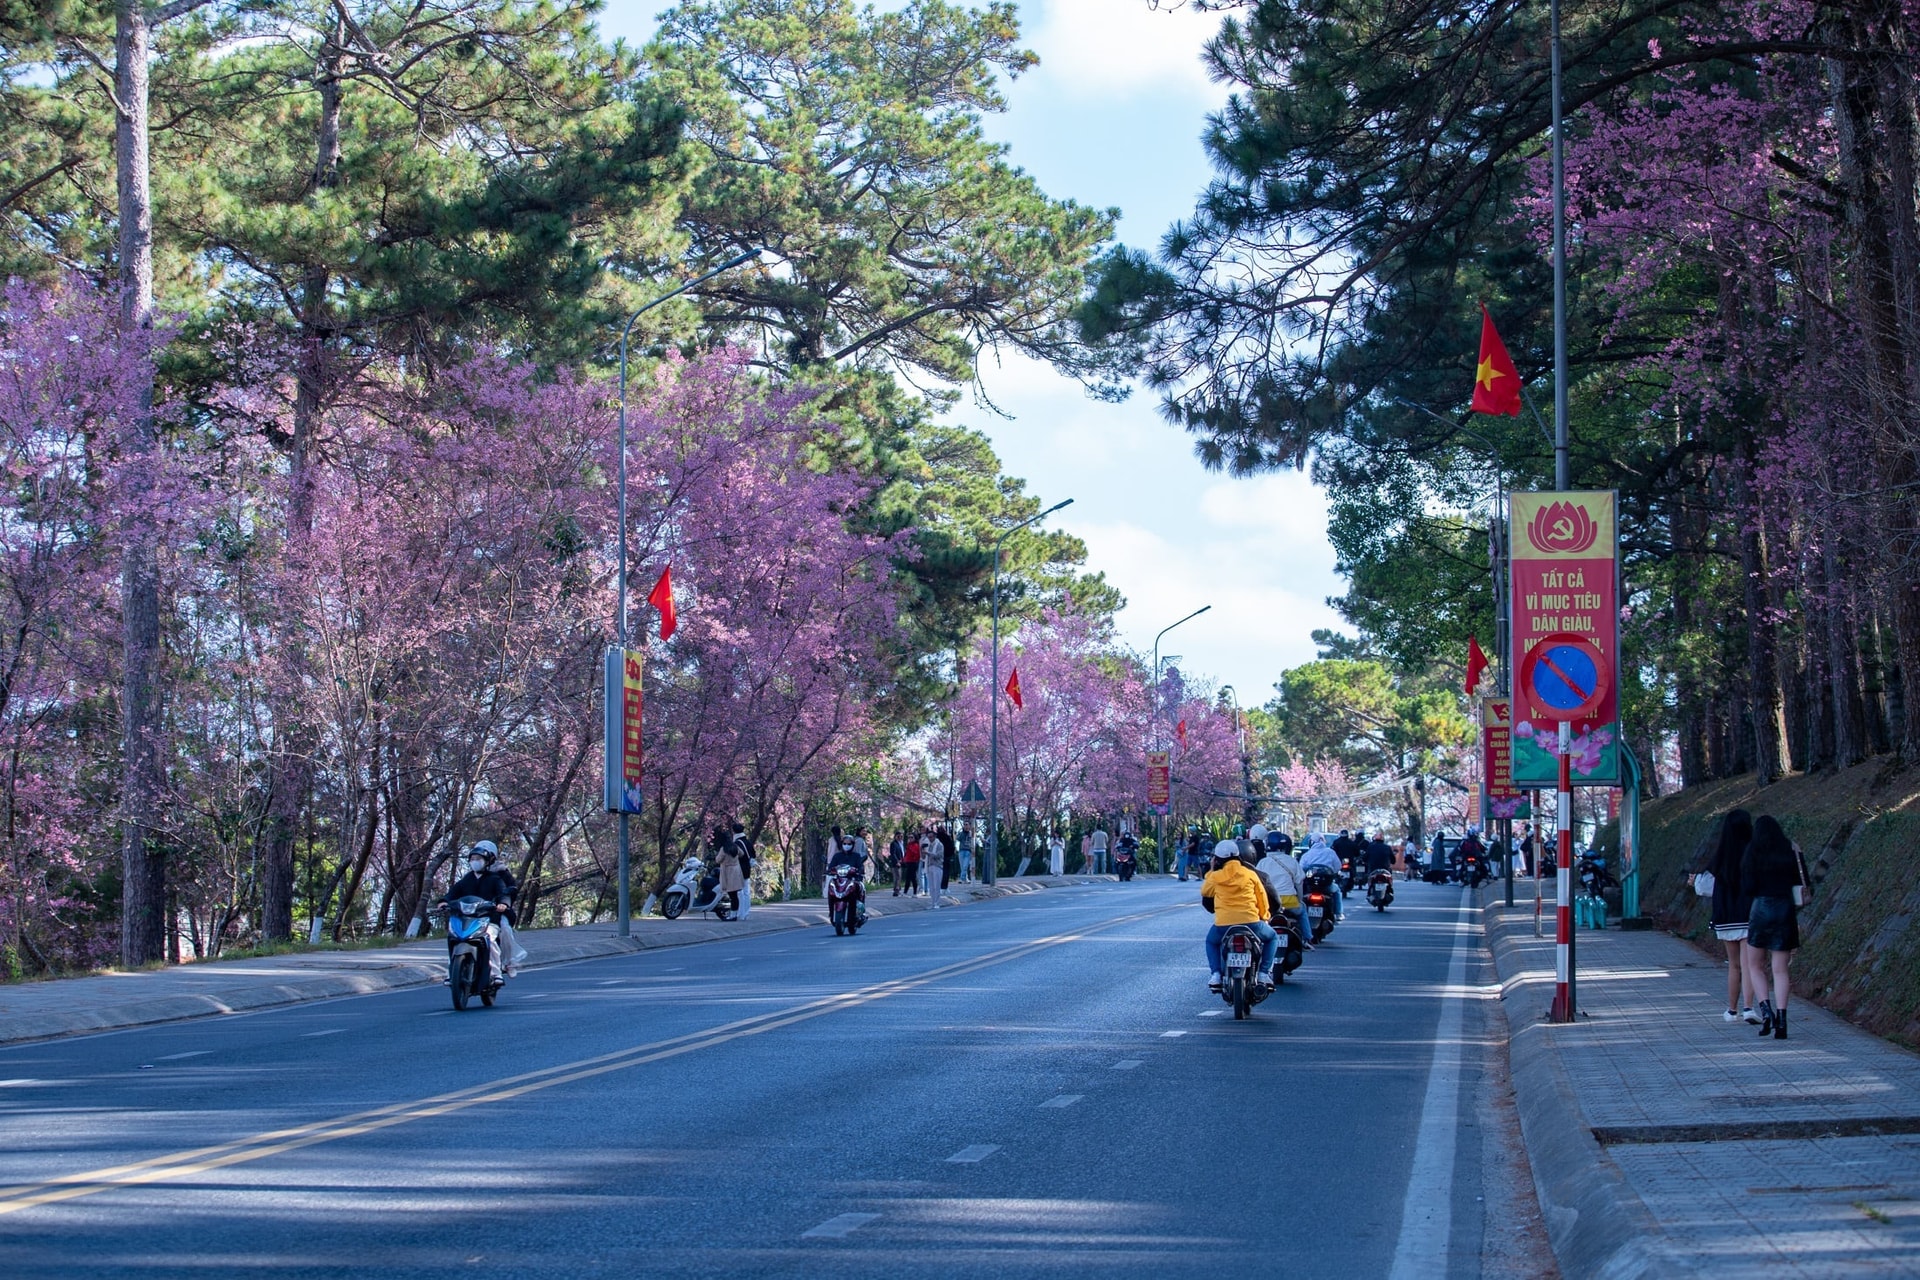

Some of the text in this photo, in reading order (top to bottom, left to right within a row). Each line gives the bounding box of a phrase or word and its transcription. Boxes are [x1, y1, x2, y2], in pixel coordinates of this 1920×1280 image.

[1541, 567, 1585, 588] TẤT CẢ
[1525, 591, 1601, 613] VÌ MỤC TIÊU
[1532, 613, 1595, 633] DÂN GIÀU,
